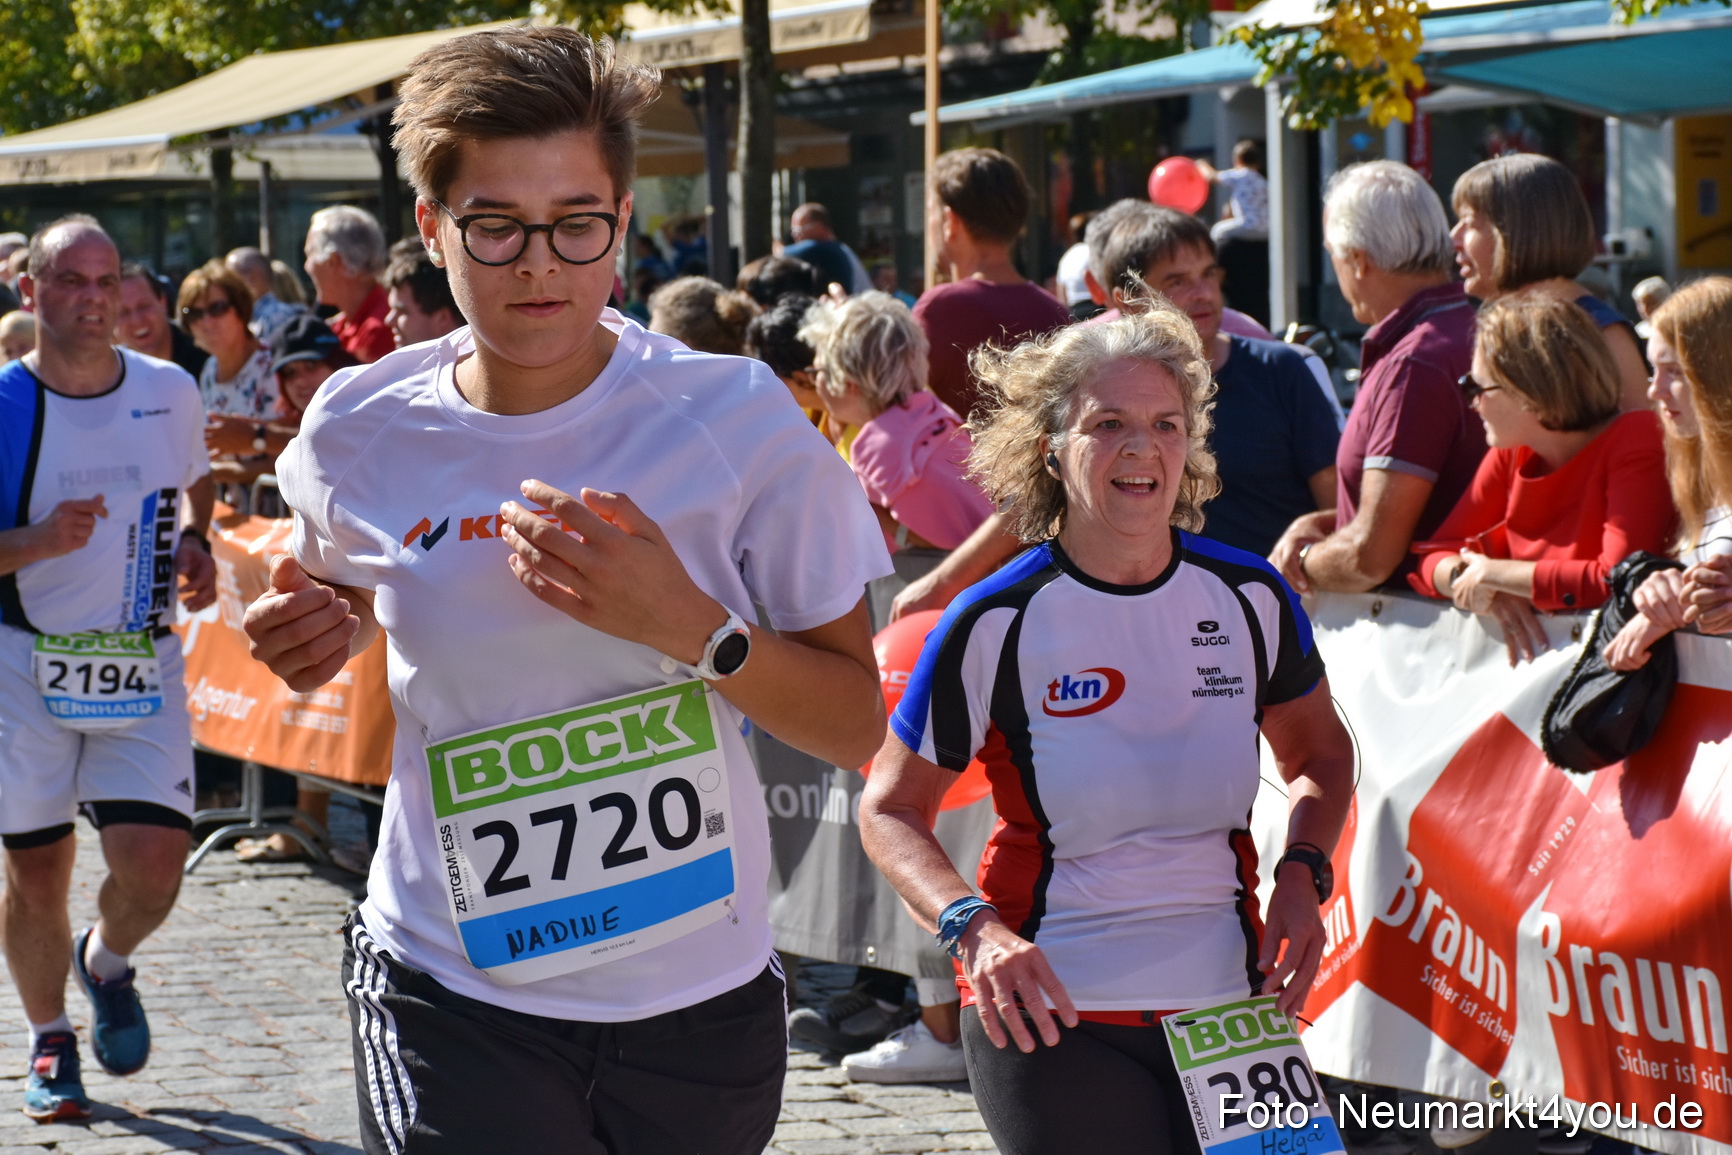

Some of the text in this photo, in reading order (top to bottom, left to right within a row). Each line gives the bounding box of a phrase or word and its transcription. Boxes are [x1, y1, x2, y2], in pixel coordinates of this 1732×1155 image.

[126, 523, 136, 559] WASTE
[123, 563, 133, 598] WATER
[48, 660, 147, 694] 2194
[1047, 675, 1101, 702] tkn
[1192, 687, 1234, 698] nürnberg
[1197, 666, 1221, 675] team
[1204, 675, 1243, 686] klinikum
[186, 676, 257, 723] Agentur
[446, 697, 690, 801] BOCK
[472, 777, 701, 898] 2720
[1528, 816, 1576, 876] Seit 1929
[506, 906, 620, 959] NADINE
[1378, 850, 1507, 1012] Braun
[1420, 964, 1514, 1046] Sicher ist sicher
[1540, 911, 1728, 1054] Braun
[1616, 1045, 1668, 1080] Sicher
[1674, 1058, 1697, 1085] ist
[1207, 1056, 1318, 1128] 280
